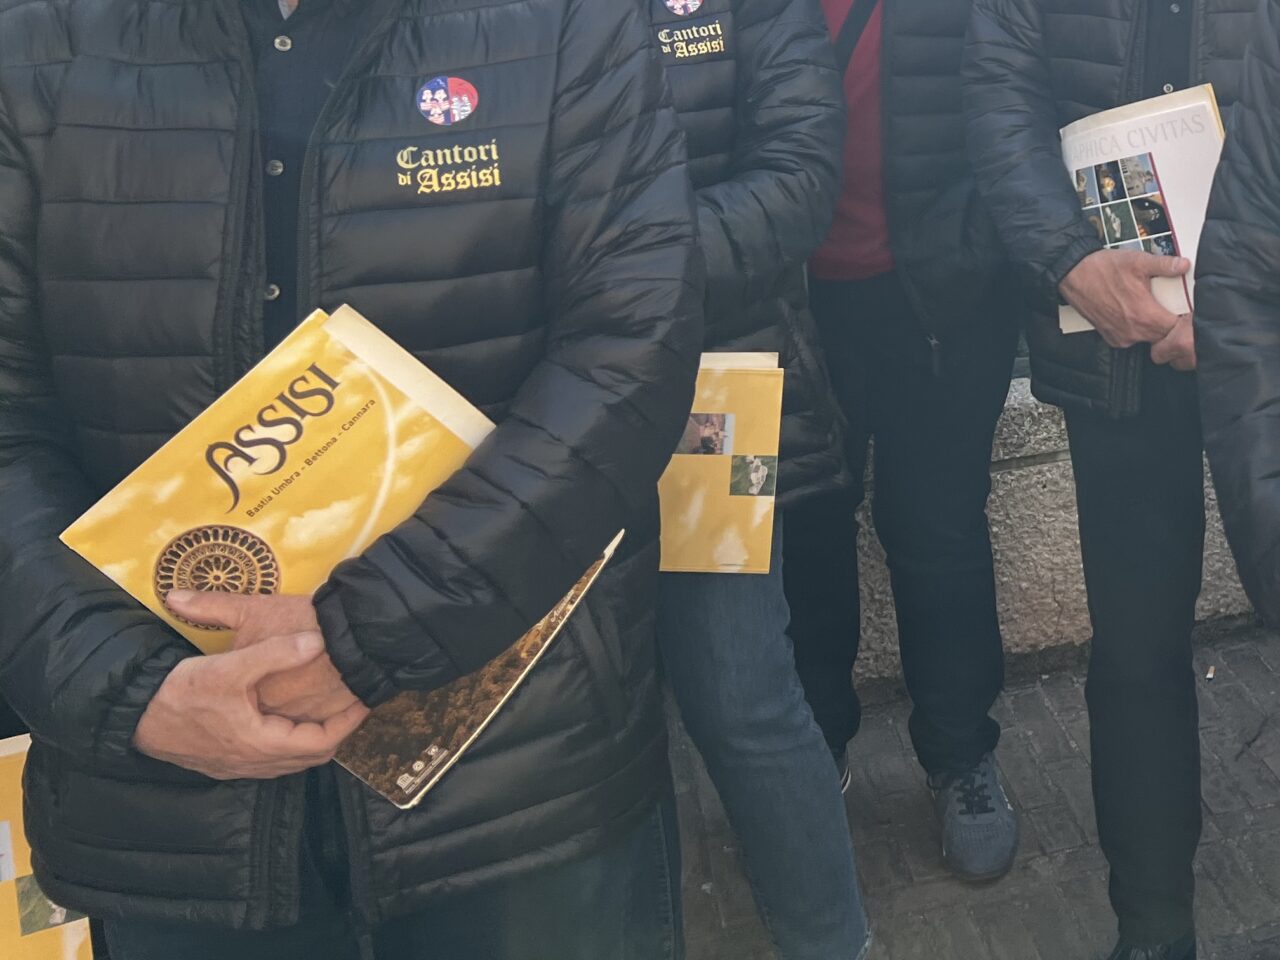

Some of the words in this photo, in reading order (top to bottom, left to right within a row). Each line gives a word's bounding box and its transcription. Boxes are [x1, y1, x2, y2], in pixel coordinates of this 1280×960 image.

[658, 20, 722, 43] Cantori
[674, 37, 725, 58] Assisi
[1127, 113, 1206, 149] CIVITAS
[396, 138, 499, 169] Cantori
[397, 172, 411, 186] di
[417, 163, 502, 194] Assisi
[205, 362, 341, 515] ASSISI
[246, 494, 273, 518] Bastia
[271, 470, 301, 496] Umbra
[304, 435, 337, 467] Bettona
[341, 398, 376, 432] Cannara
